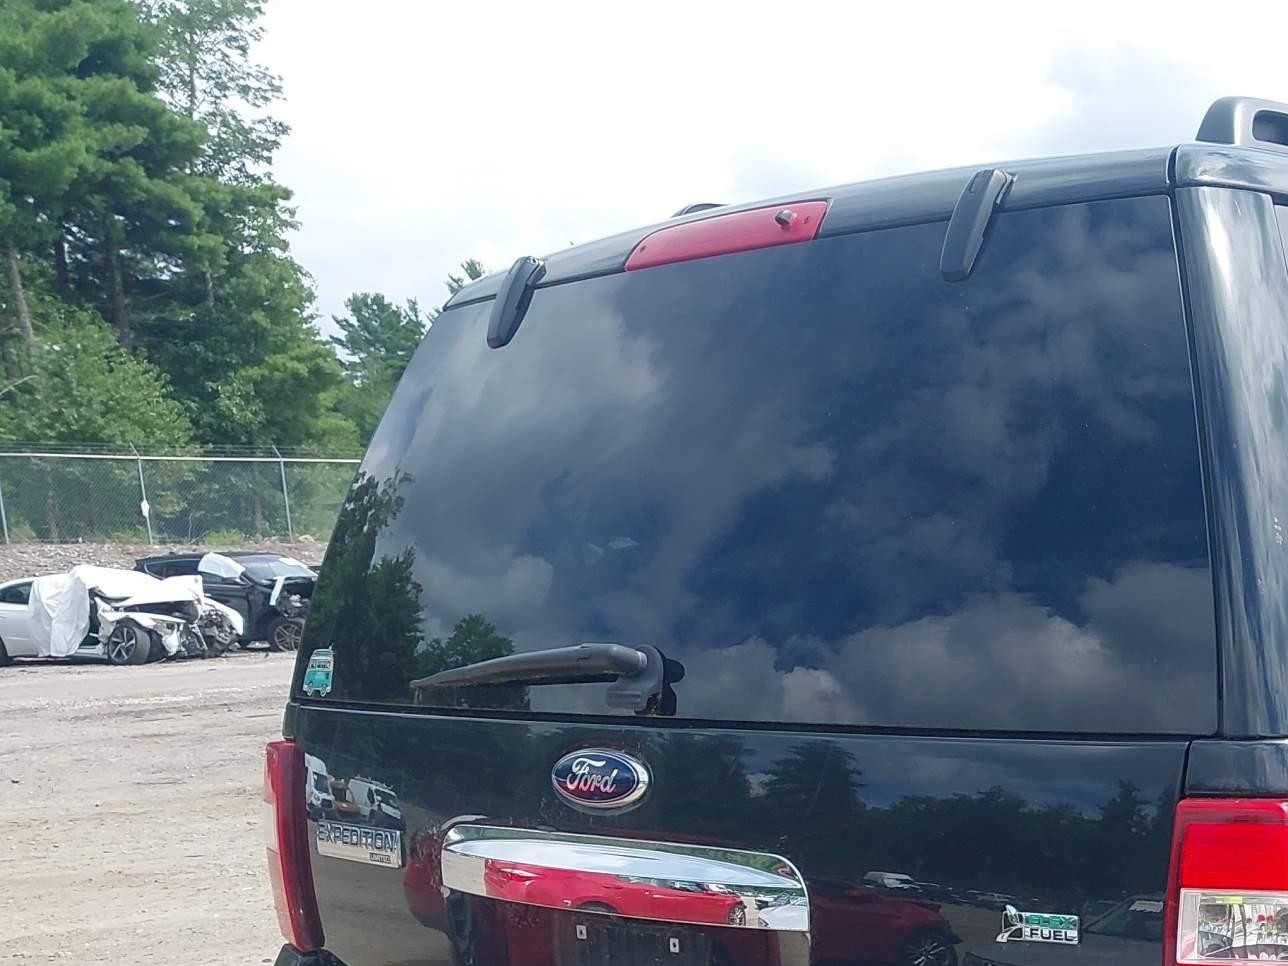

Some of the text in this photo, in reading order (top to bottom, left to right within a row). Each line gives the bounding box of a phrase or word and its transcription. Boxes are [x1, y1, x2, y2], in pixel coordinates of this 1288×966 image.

[566, 757, 619, 793] Ford
[317, 821, 396, 851] EXPEDITION
[1027, 913, 1078, 930] FLEX
[1029, 928, 1078, 942] FUEL
